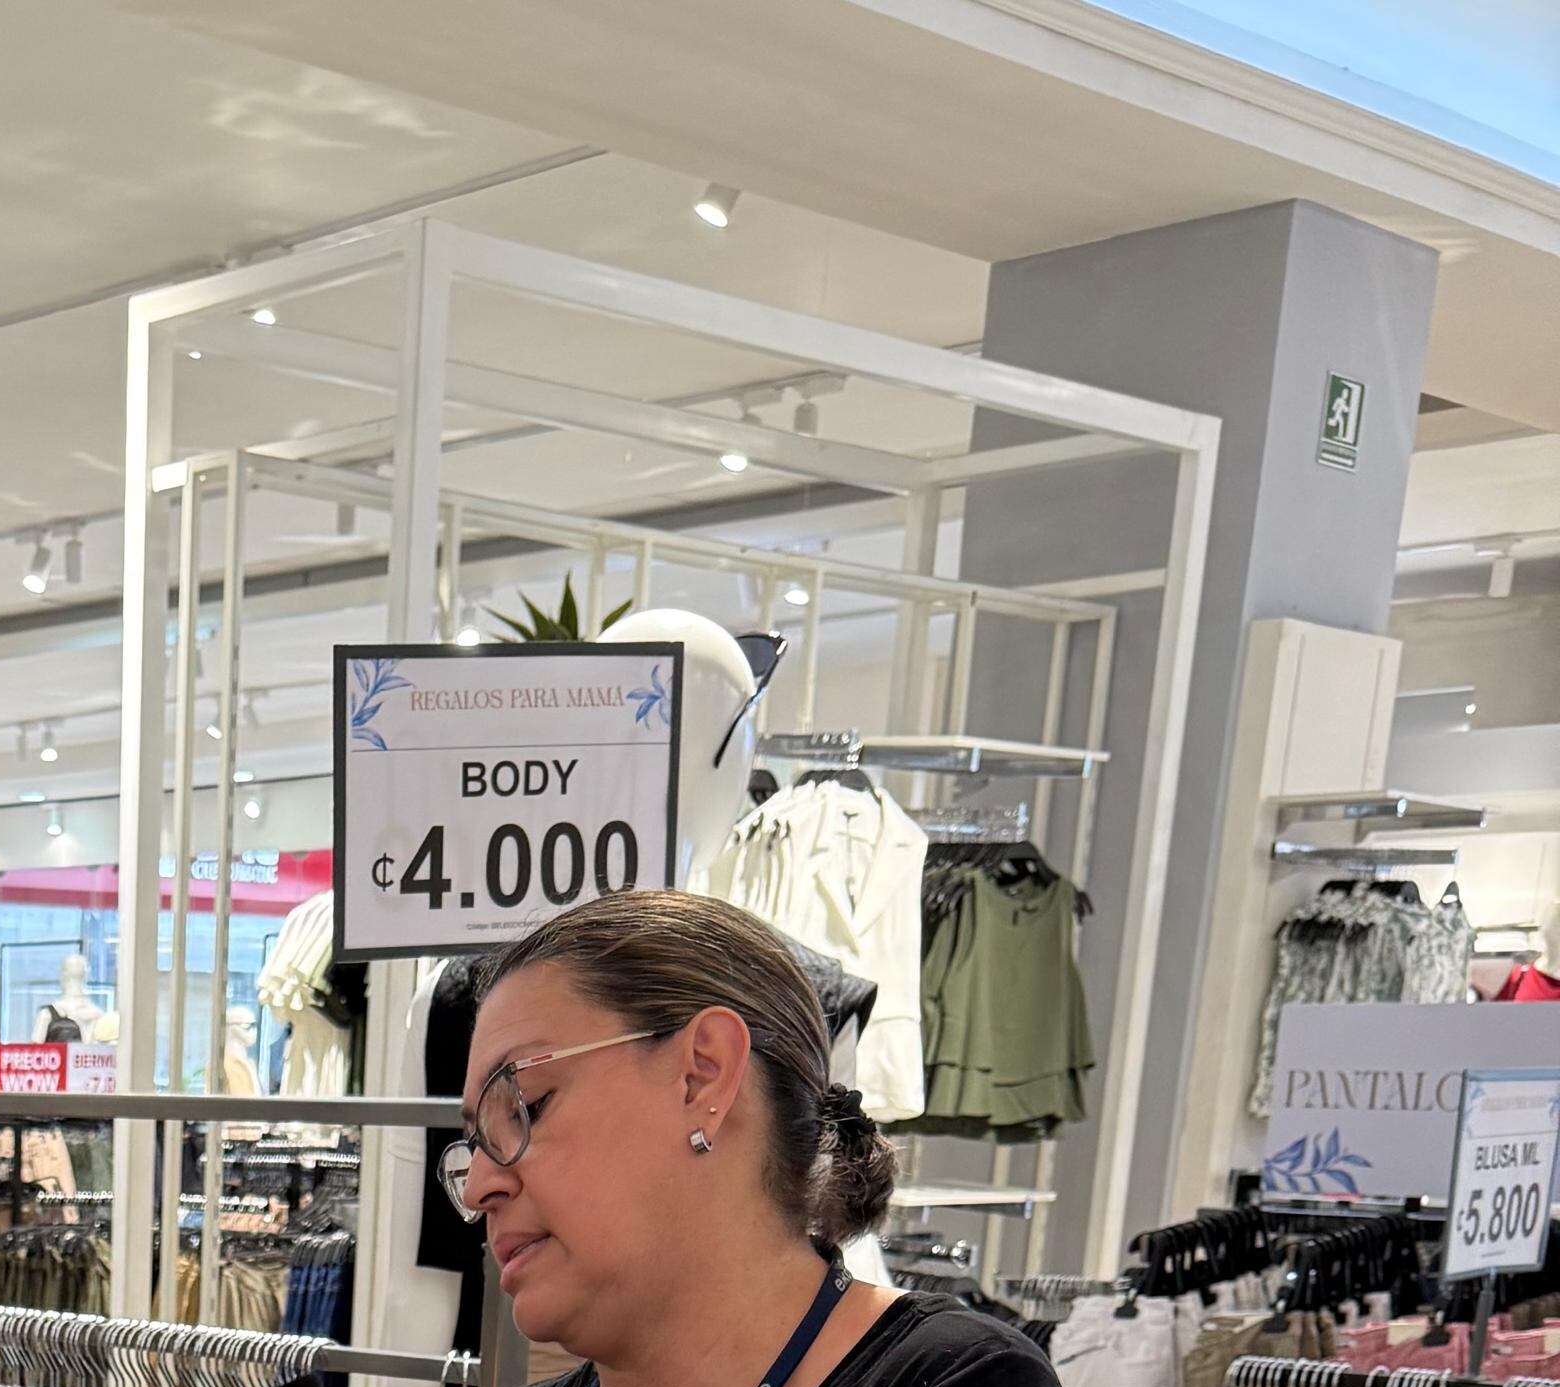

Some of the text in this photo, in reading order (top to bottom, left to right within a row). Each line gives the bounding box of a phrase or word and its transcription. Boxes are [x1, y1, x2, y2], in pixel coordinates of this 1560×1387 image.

[410, 689, 504, 711] REGALOS
[510, 688, 559, 709] PARA
[461, 759, 579, 798] BODY
[0, 1051, 61, 1071] PRECIO
[0, 1072, 60, 1092] WOW
[1474, 1141, 1541, 1170] BLUSA ML
